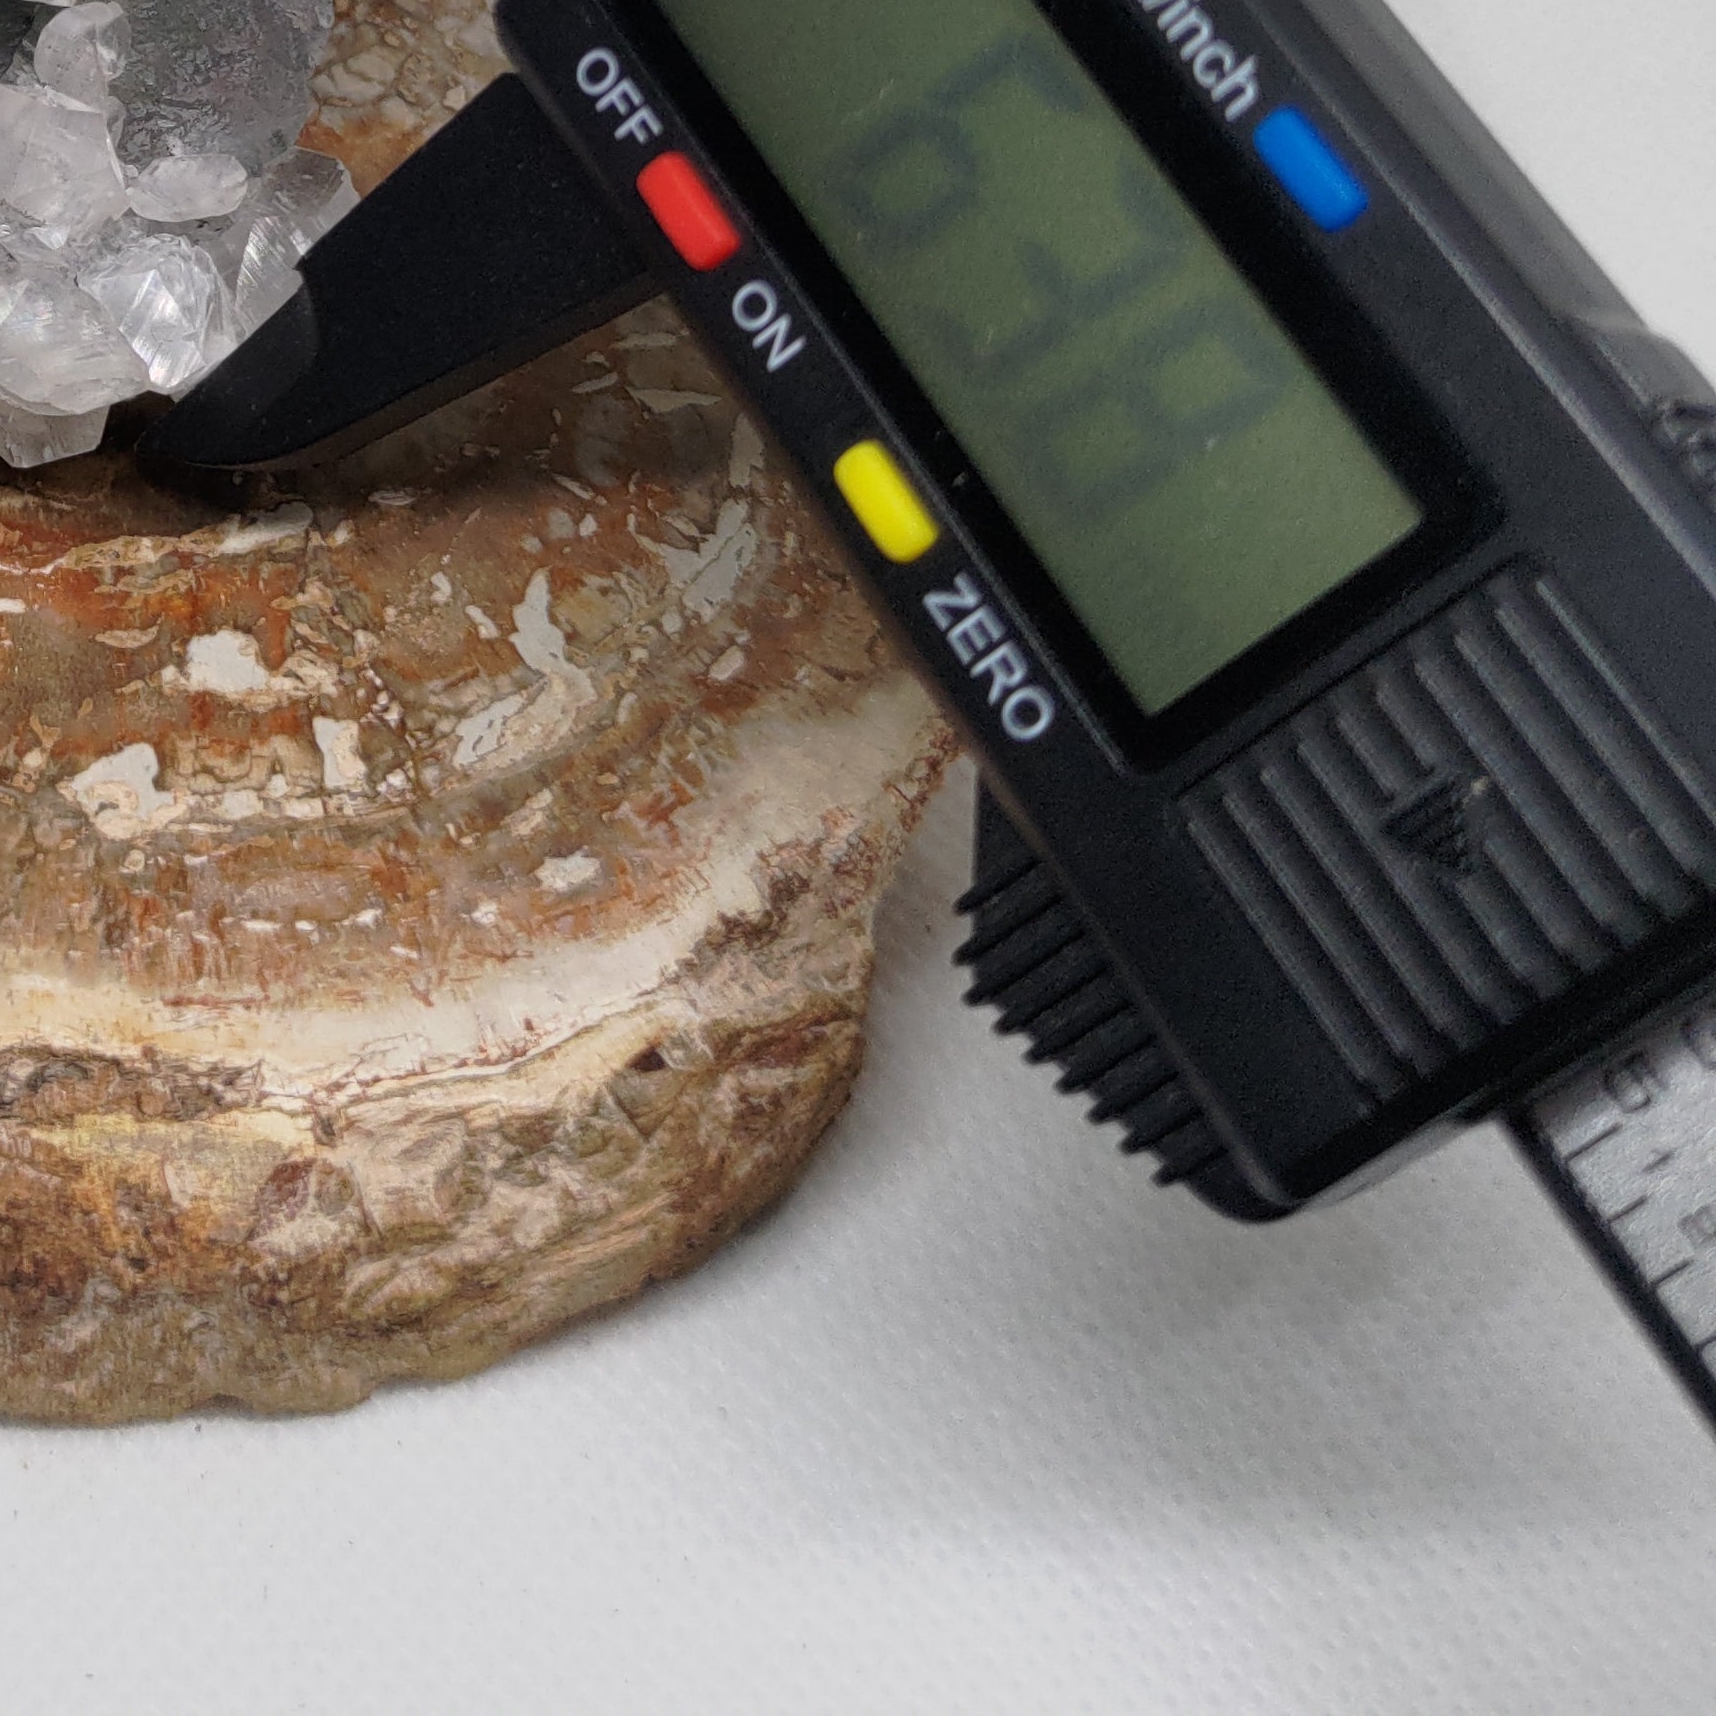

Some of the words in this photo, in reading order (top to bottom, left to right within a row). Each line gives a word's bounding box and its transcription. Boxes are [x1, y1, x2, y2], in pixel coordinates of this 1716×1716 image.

[575, 48, 663, 144] OFF
[731, 281, 806, 372] ON
[922, 572, 1055, 743] ZERO
